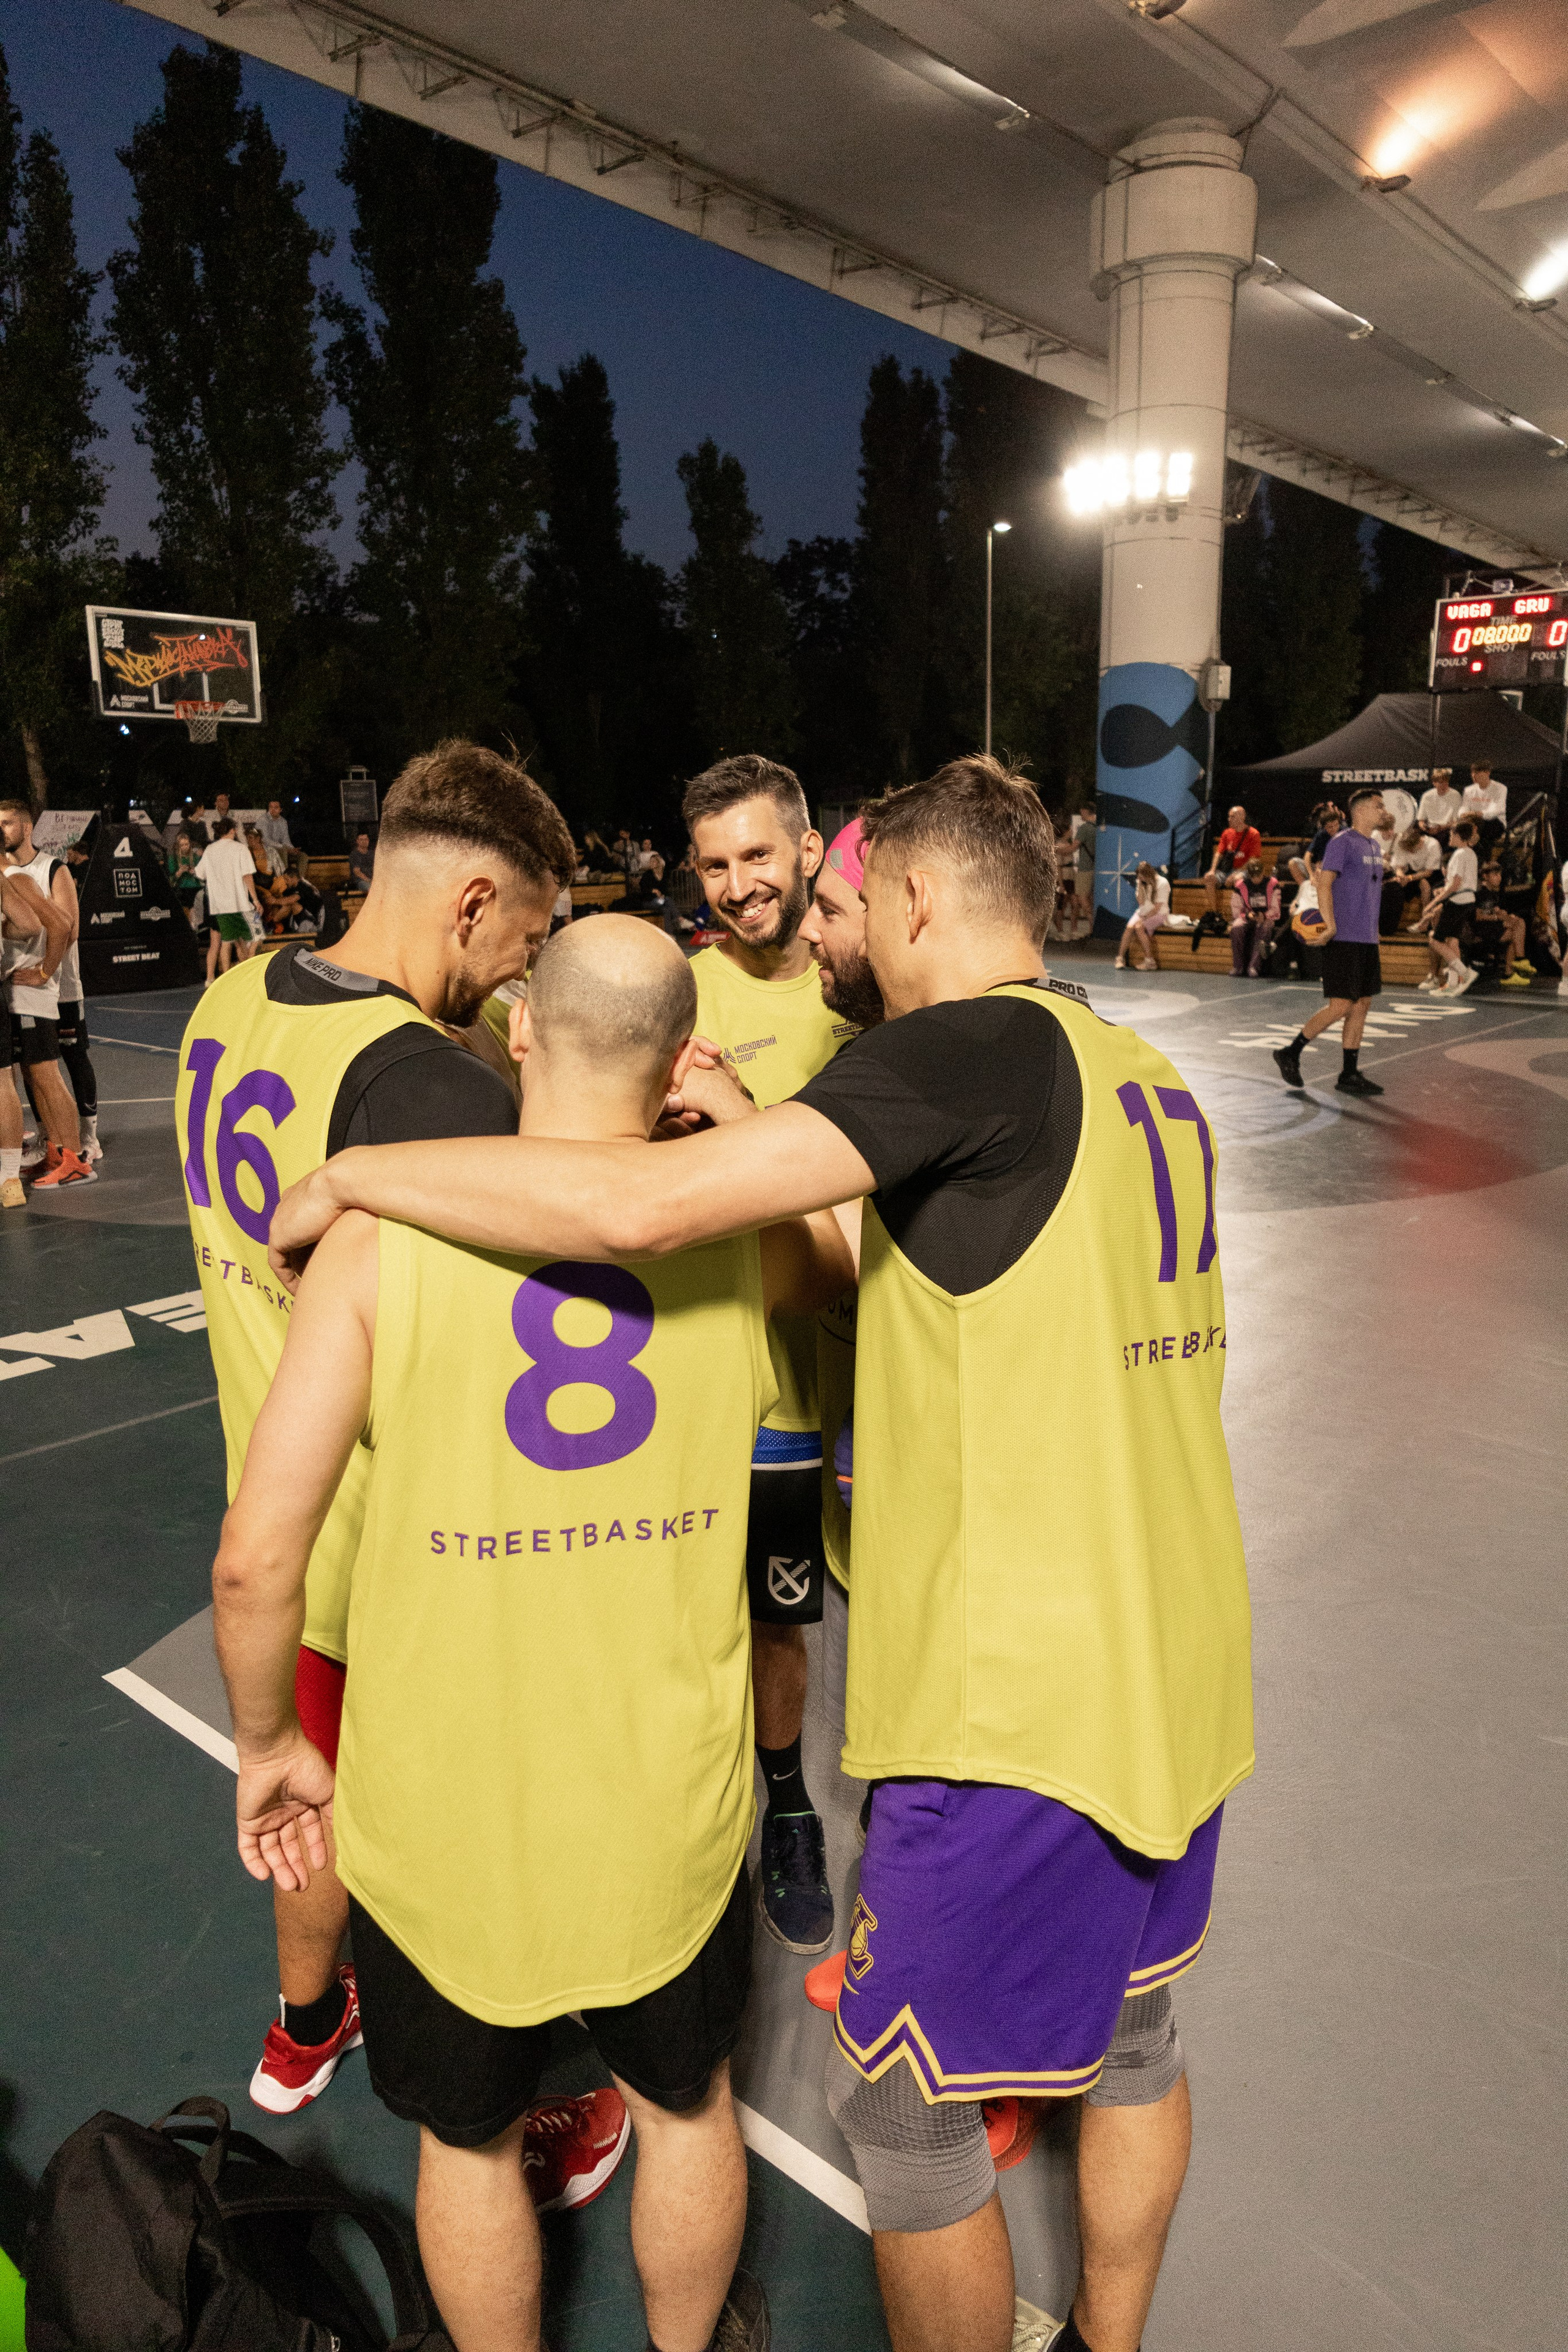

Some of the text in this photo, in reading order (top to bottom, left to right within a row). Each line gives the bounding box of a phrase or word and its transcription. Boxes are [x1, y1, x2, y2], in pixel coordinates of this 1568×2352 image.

[1447, 597, 1550, 620] VAGA GRU
[1490, 615, 1517, 626] TIME
[1453, 628, 1472, 653] 0
[1548, 620, 1568, 646] 0
[1484, 643, 1516, 654] SHOT
[1435, 657, 1468, 668] FOULS
[114, 837, 134, 858] 4
[303, 957, 342, 981] NIKE PRO
[1049, 979, 1075, 995] PRO
[734, 1035, 777, 1054] МОСКОВСКИЙ
[737, 1051, 757, 1064] СПОРТ
[186, 1038, 296, 1245] 16
[1115, 1080, 1216, 1282] 17
[505, 1260, 657, 1471] 8
[430, 1508, 719, 1560] STREETBASKET
